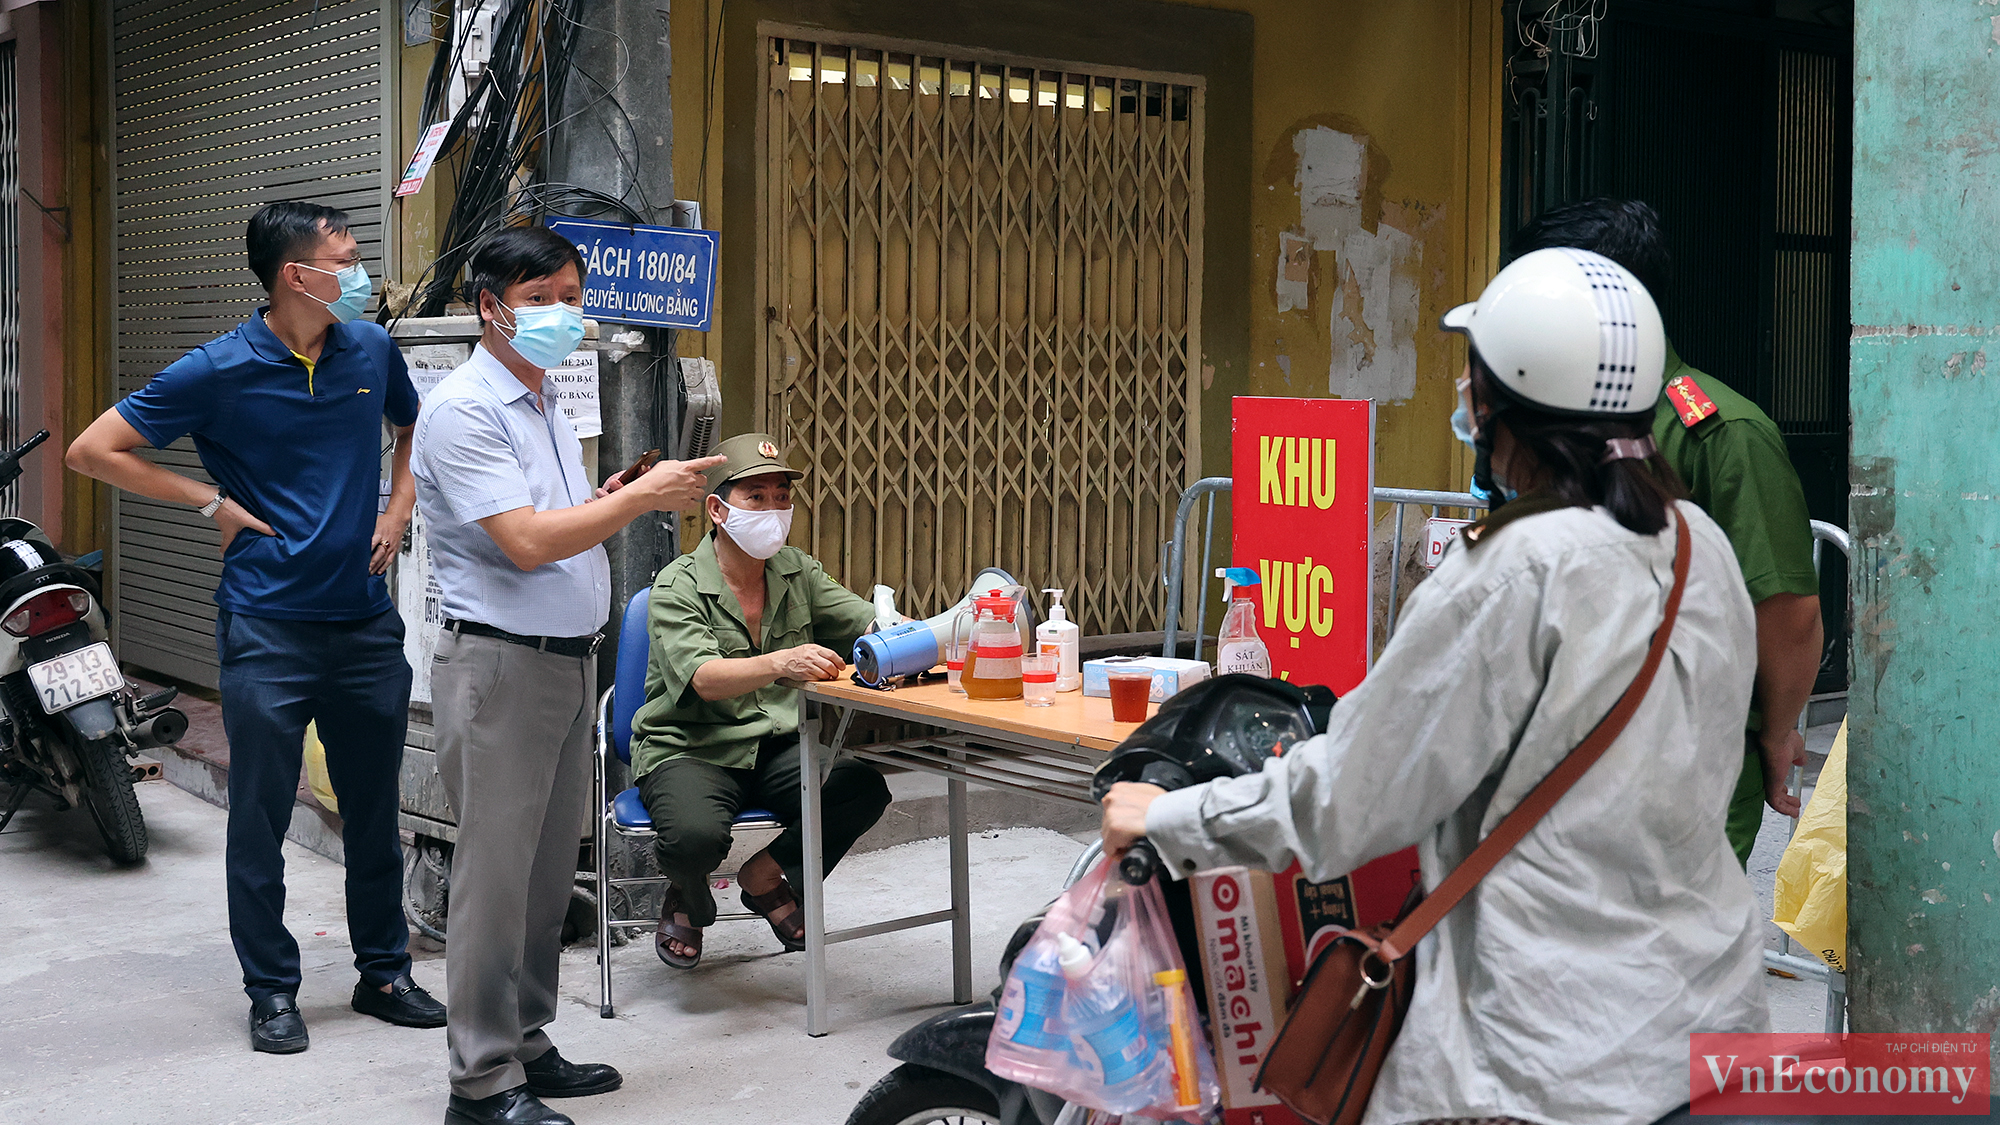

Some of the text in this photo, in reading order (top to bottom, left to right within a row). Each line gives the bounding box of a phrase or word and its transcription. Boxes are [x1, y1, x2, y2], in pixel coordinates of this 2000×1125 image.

[637, 250, 696, 285] 180/84
[666, 288, 699, 318] BẰNG
[554, 374, 575, 383] KHO
[577, 374, 595, 385] BẠC
[576, 358, 593, 367] 24M
[1259, 435, 1337, 510] KHU
[1259, 556, 1334, 649] VỰC
[41, 649, 103, 685] 29-X3
[44, 668, 118, 709] 212.56
